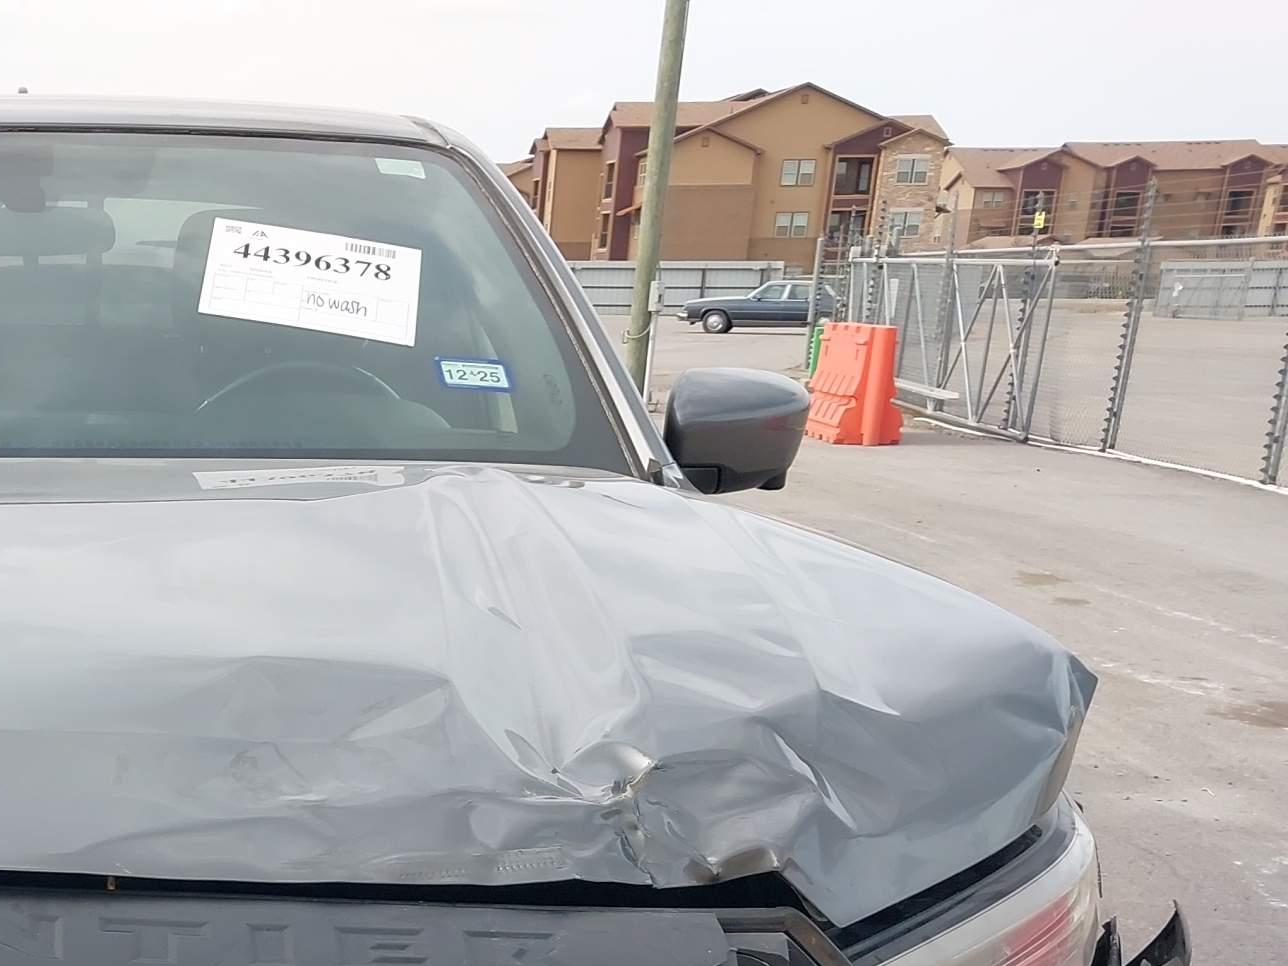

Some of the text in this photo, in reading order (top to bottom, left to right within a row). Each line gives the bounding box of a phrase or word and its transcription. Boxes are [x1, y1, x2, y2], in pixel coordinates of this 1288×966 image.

[232, 242, 392, 281] 44396378
[306, 293, 368, 317] no wash
[444, 368, 501, 383] 12 25
